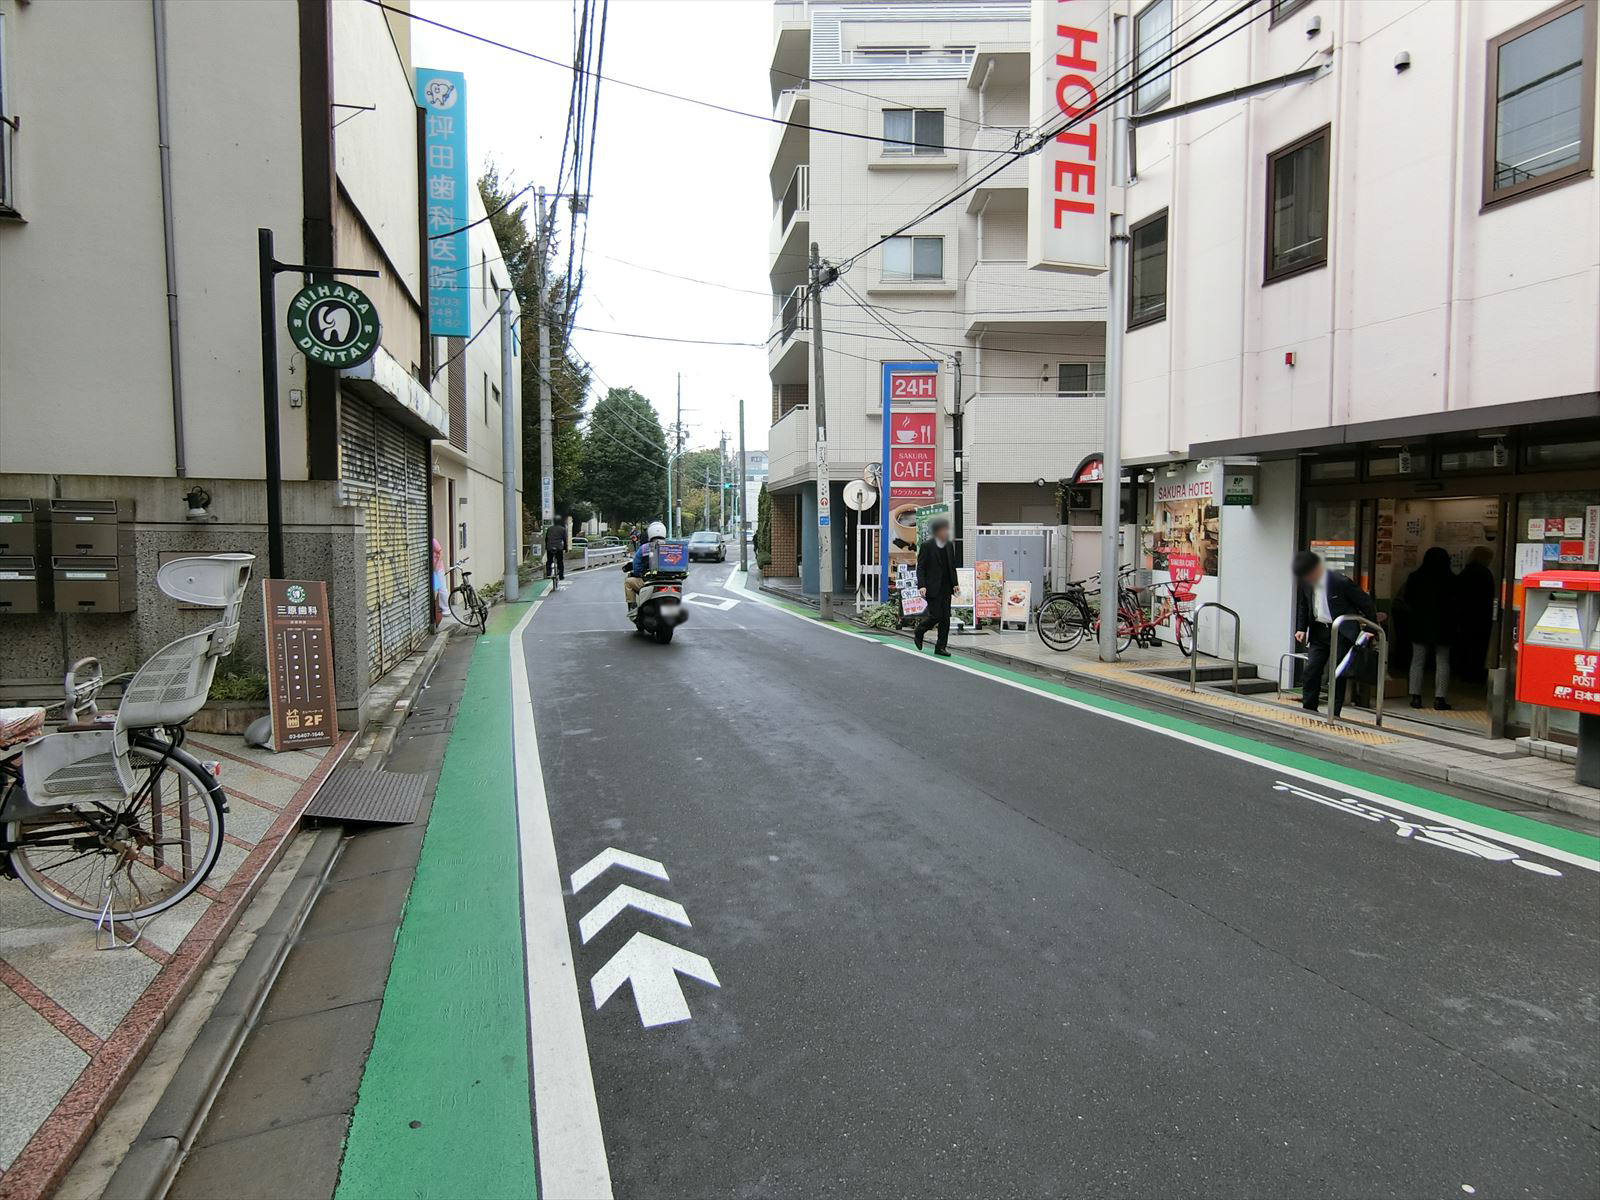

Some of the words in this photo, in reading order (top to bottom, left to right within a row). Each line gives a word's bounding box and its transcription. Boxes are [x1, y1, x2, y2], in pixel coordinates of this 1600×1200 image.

[1054, 24, 1098, 229] HOTEL
[429, 114, 458, 292] 坪田歯科医院
[296, 285, 370, 314] MIHARA
[299, 336, 370, 362] DENTAL
[895, 379, 932, 395] 24H
[898, 452, 928, 460] SAKURA
[894, 461, 933, 478] CAFE
[1158, 484, 1186, 500] SAKURA
[1188, 481, 1213, 497] HOTEL
[277, 605, 318, 615] 三原歯科
[1573, 654, 1598, 668] 郵便
[1572, 674, 1596, 688] POST
[304, 714, 323, 727] 2F
